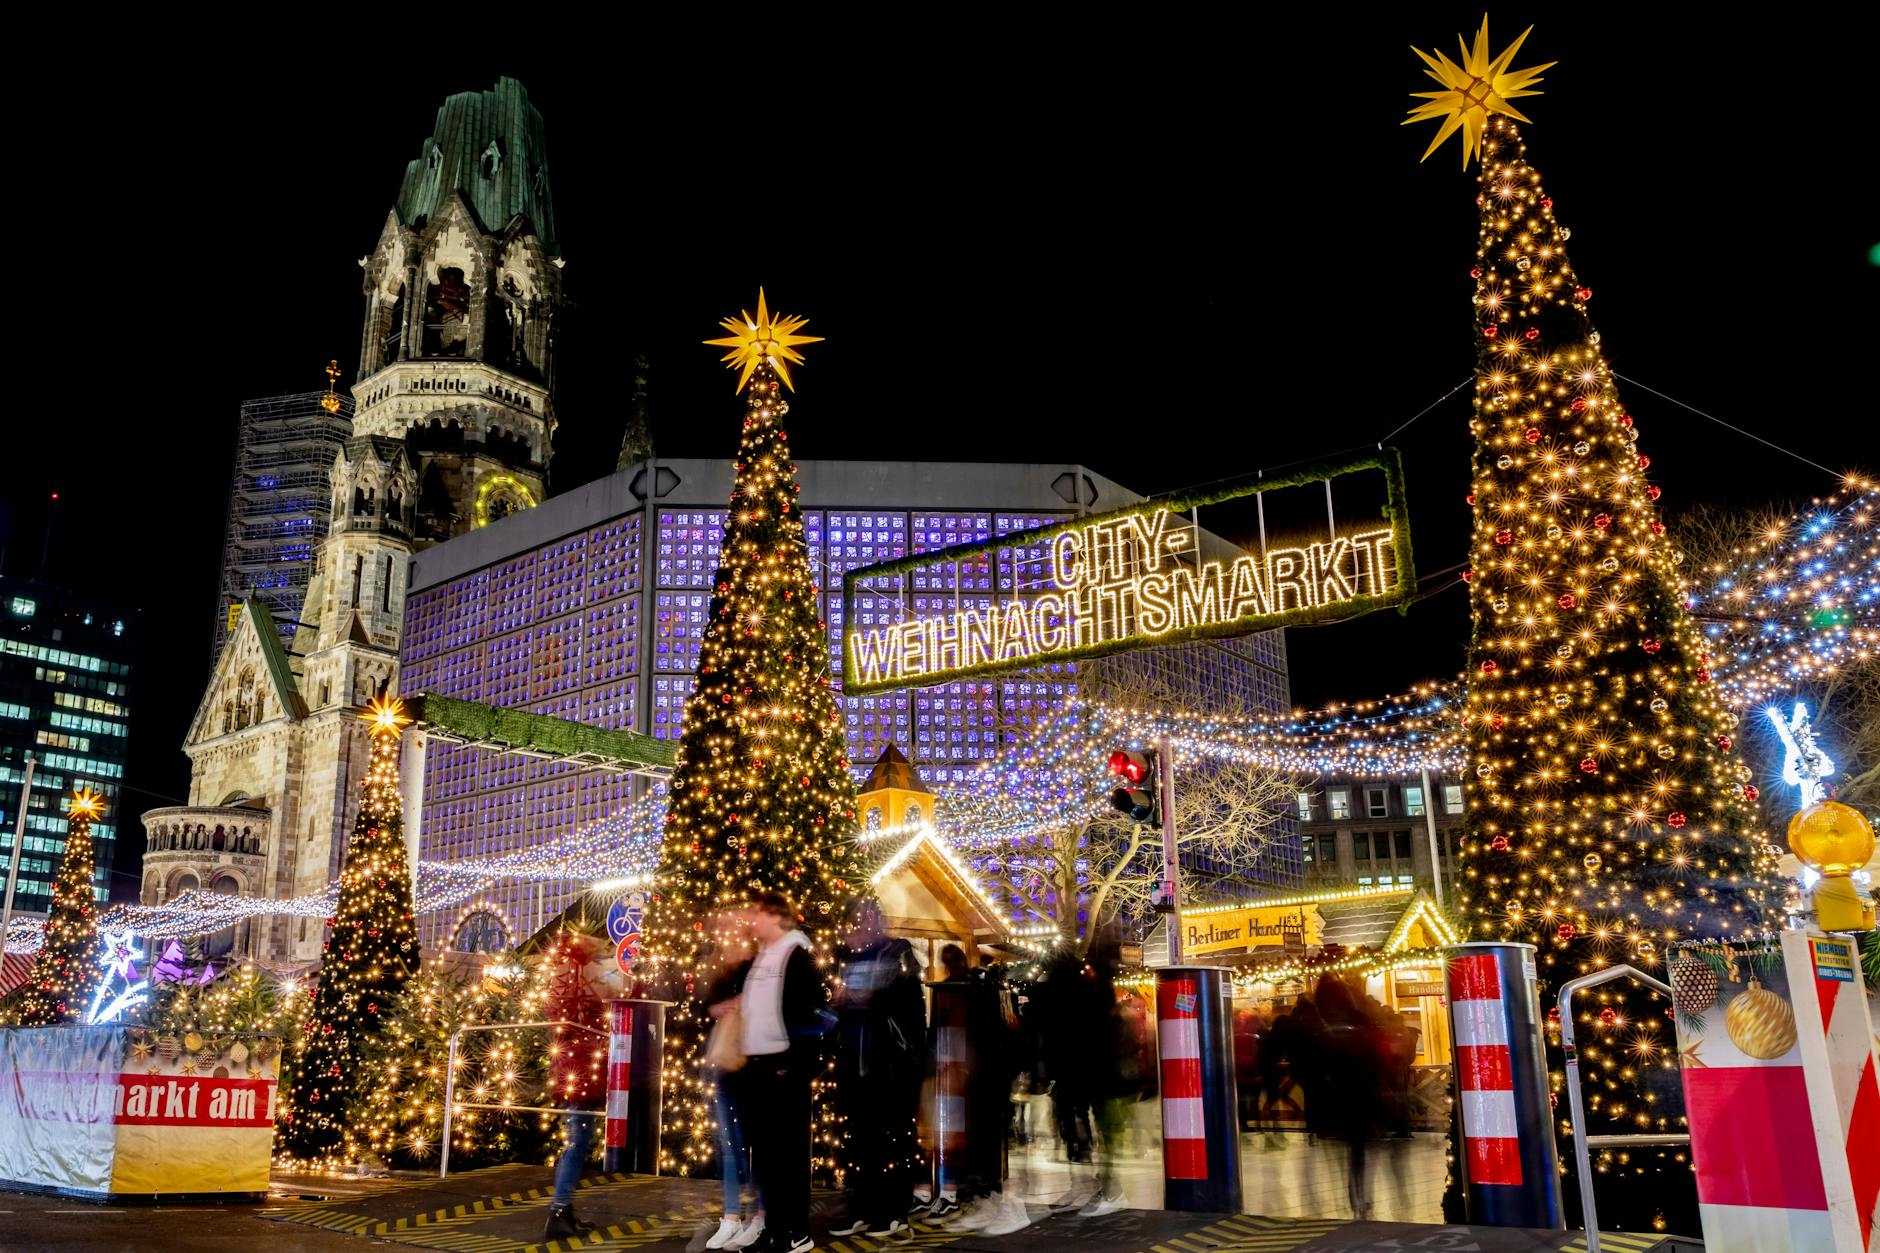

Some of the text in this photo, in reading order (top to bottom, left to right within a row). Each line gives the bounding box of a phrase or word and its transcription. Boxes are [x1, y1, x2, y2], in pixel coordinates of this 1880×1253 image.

[1051, 508, 1189, 591] CITY-
[849, 528, 1395, 685] WEIHNACHTSMARKT
[1188, 923, 1241, 946] Berliner
[1408, 985, 1445, 994] Handbro
[209, 1086, 255, 1120] am
